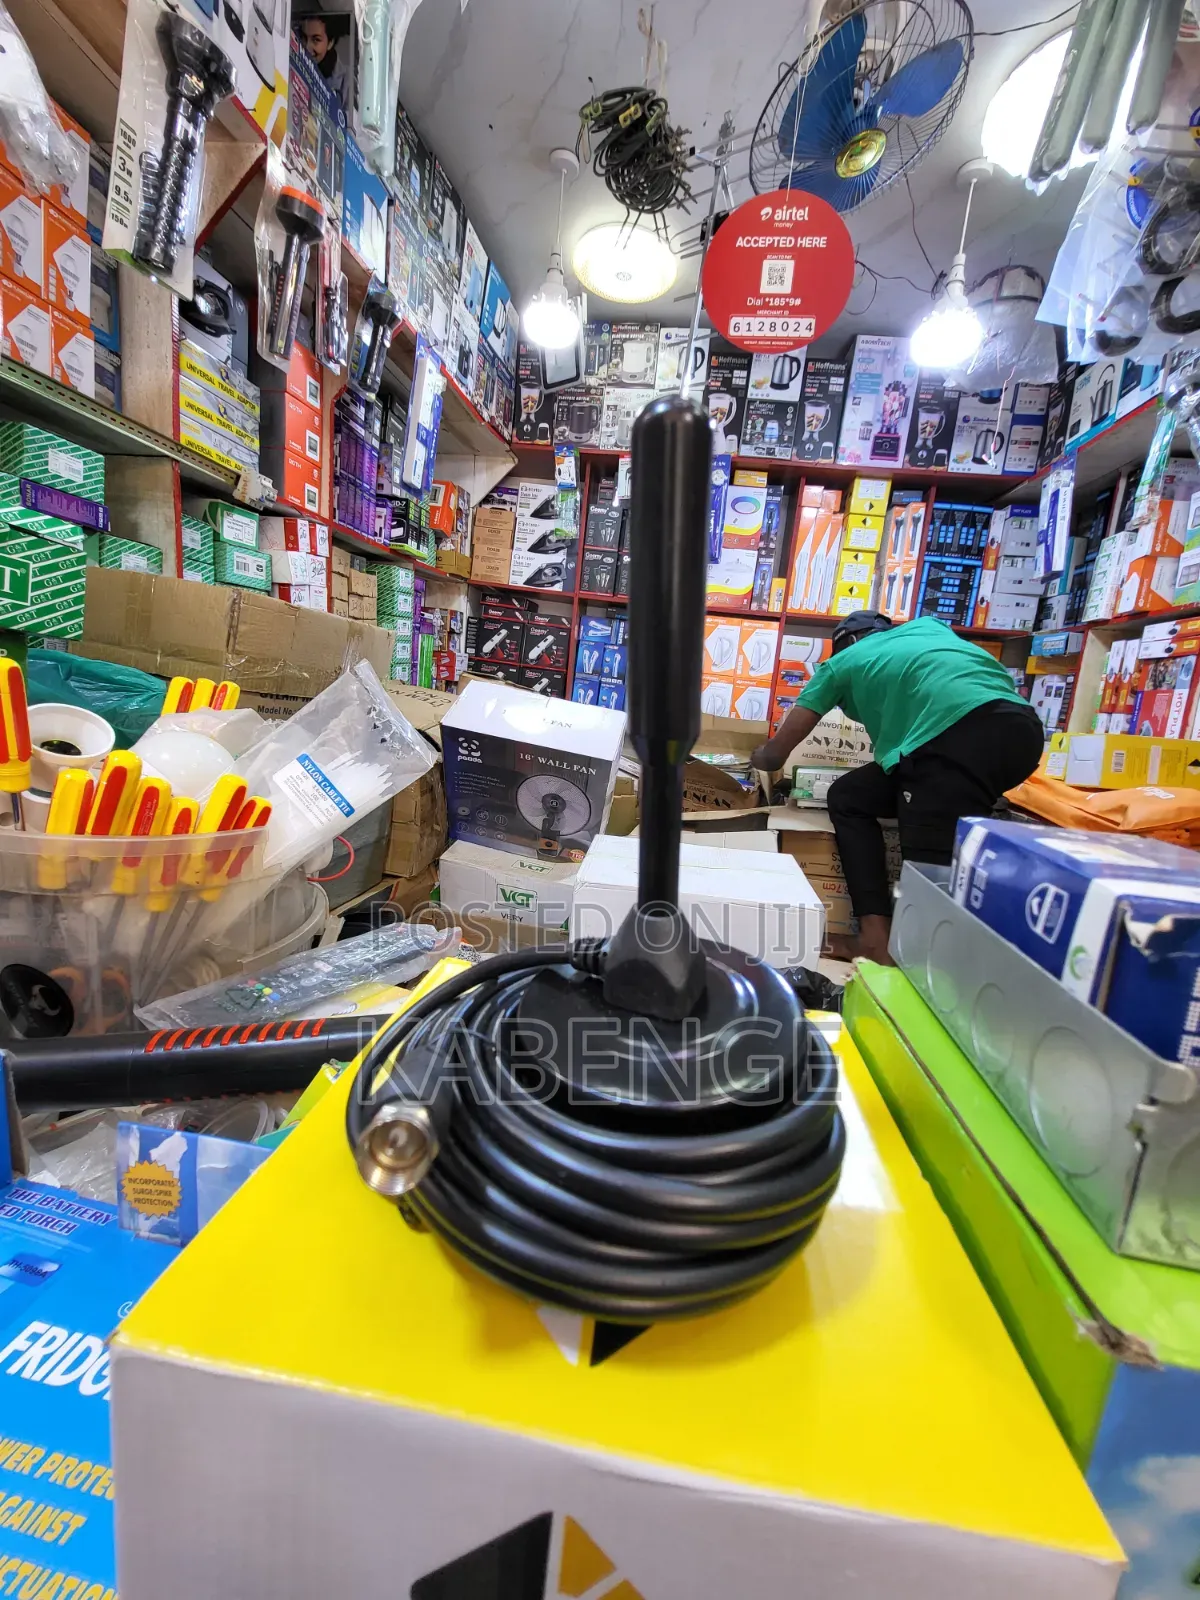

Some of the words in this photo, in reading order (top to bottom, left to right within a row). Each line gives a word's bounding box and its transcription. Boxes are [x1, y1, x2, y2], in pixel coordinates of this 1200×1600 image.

[120, 129, 136, 147] 1600
[774, 204, 809, 221] airtel
[736, 236, 795, 248] ACCEPTED
[797, 236, 827, 248] HERE
[746, 297, 764, 306] Dial
[732, 321, 813, 333] 6128024
[815, 361, 847, 371] Hoffmans
[186, 362, 215, 386] UNIVERSAL
[218, 381, 236, 398] TRAVEL
[237, 394, 256, 411] ADAPTOR
[184, 400, 214, 423] UNIVERSAL
[216, 418, 234, 435] TRAVEL
[185, 438, 214, 458] UNIVERSAL
[215, 453, 232, 468] TRAVEL
[1, 511, 20, 521] G&T
[27, 520, 47, 531] G&T
[56, 529, 75, 539] G&T
[6, 542, 28, 554] G&T
[32, 551, 52, 562] G&T
[59, 558, 78, 570] G&T
[44, 576, 63, 587] G&T
[32, 592, 52, 604] G&T
[55, 599, 75, 611] G&T
[17, 610, 37, 623] G&T
[44, 615, 64, 628] G&T
[257, 704, 282, 715] Model
[457, 754, 483, 764] panda
[537, 756, 571, 770] WALL
[573, 764, 597, 776] FAN
[301, 759, 324, 784] NYLON
[320, 781, 341, 804] CABLE
[339, 800, 352, 815] TIE
[682, 789, 731, 809] ONGAN
[519, 860, 550, 873] VGT
[500, 887, 535, 910] VGT
[500, 911, 524, 923] VERY
[128, 1177, 175, 1188] INCORPORATES
[132, 1187, 173, 1198] SURGE/SPIKE
[7, 1187, 39, 1206] THE
[36, 1195, 118, 1226] BATTERY
[133, 1197, 174, 1208] PROTECTION
[20, 1208, 80, 1236] TORCH
[0, 1319, 111, 1401] FRIDG
[33, 1451, 116, 1501] PROTE
[0, 1491, 88, 1546] GAINST
